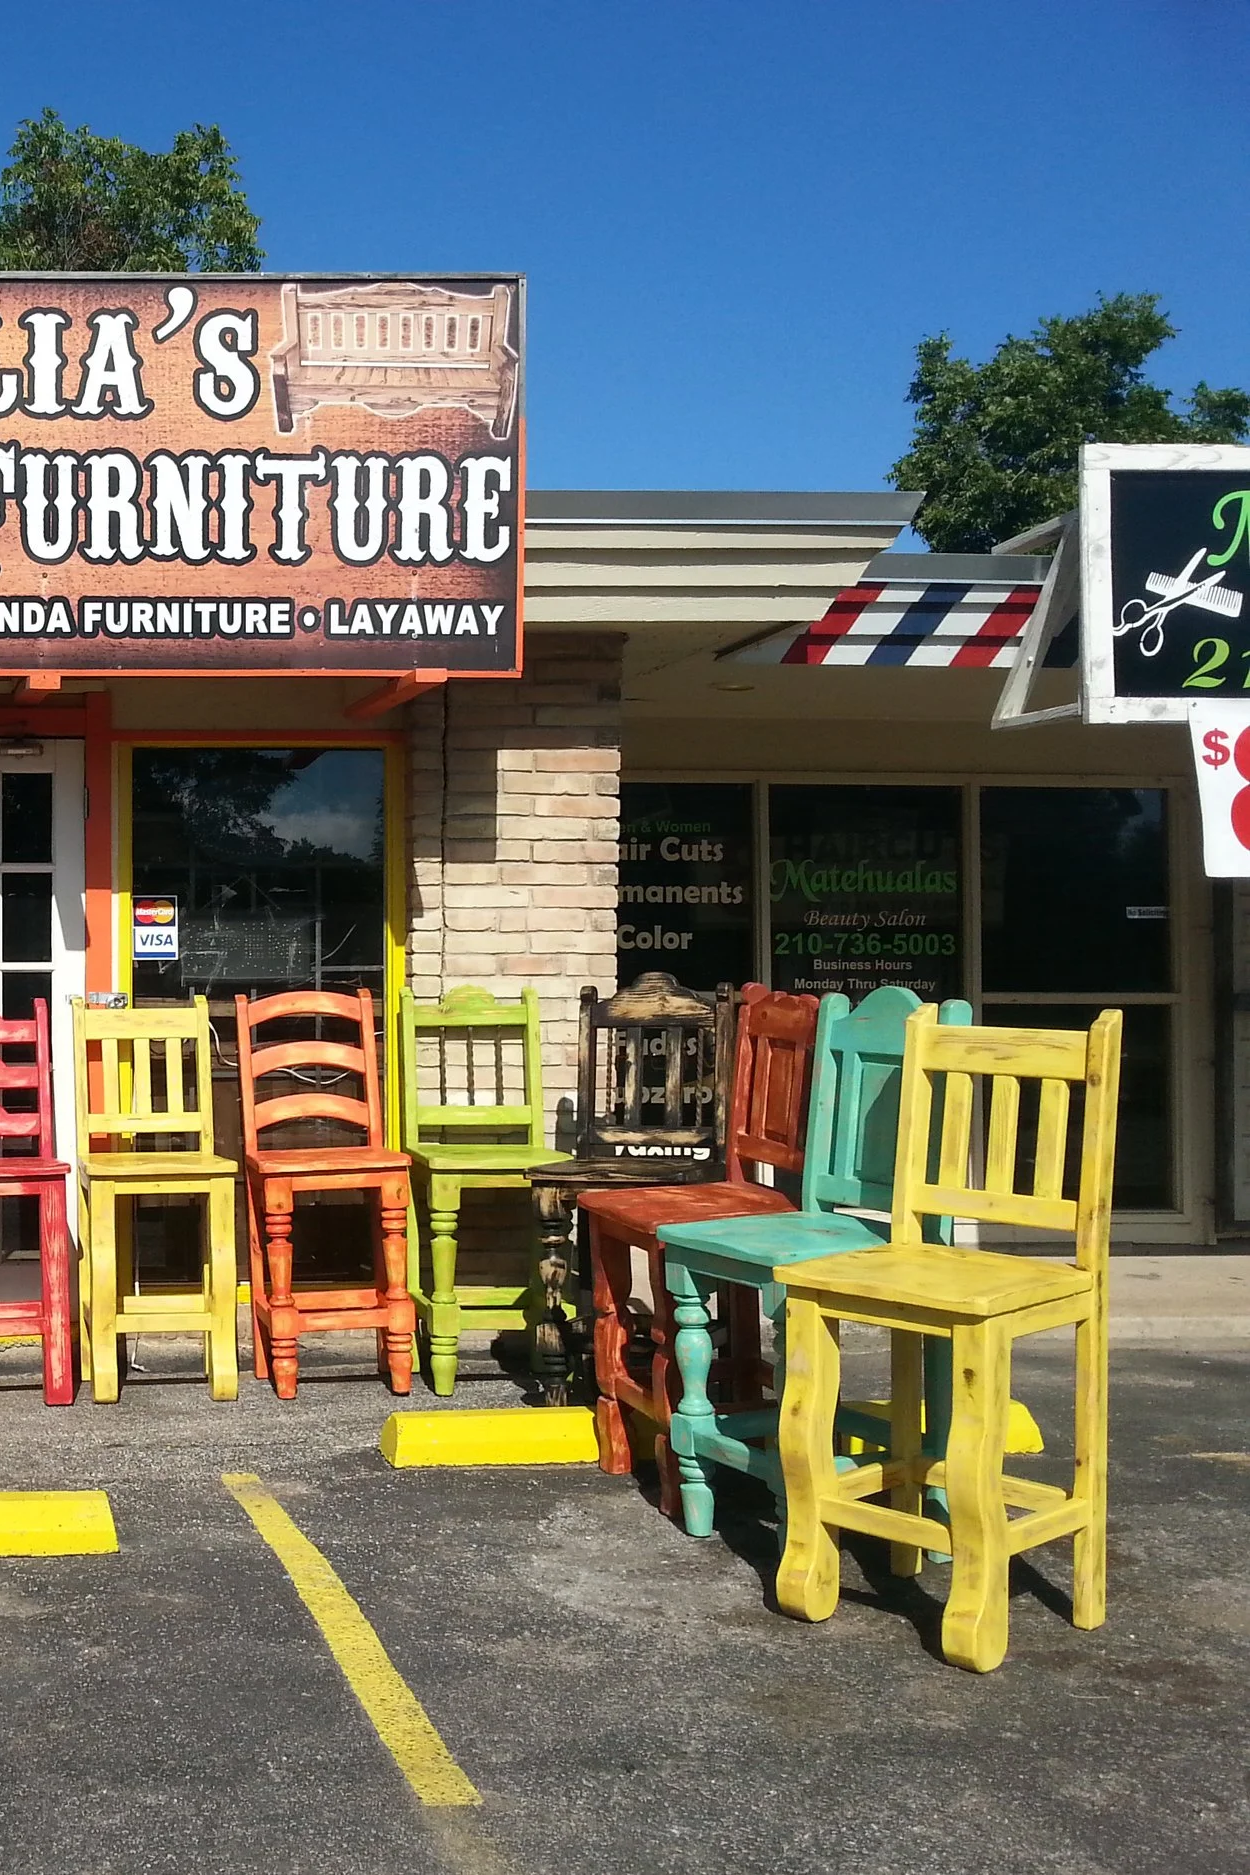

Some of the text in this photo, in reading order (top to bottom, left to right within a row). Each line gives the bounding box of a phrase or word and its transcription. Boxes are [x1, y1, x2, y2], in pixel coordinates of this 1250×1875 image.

[84, 602, 290, 634] FURNITURE
[330, 604, 505, 635] LAYAWAY
[655, 820, 711, 833] Women
[659, 836, 724, 862] Cuts
[771, 858, 957, 902] Matehualas
[804, 909, 927, 930] Beauty Salon
[139, 934, 173, 946] VISA
[617, 924, 693, 950] Color
[774, 932, 956, 956] 210-736-5003
[813, 958, 913, 970] Business Hours
[794, 978, 844, 992] Monday
[847, 978, 874, 990] Thru
